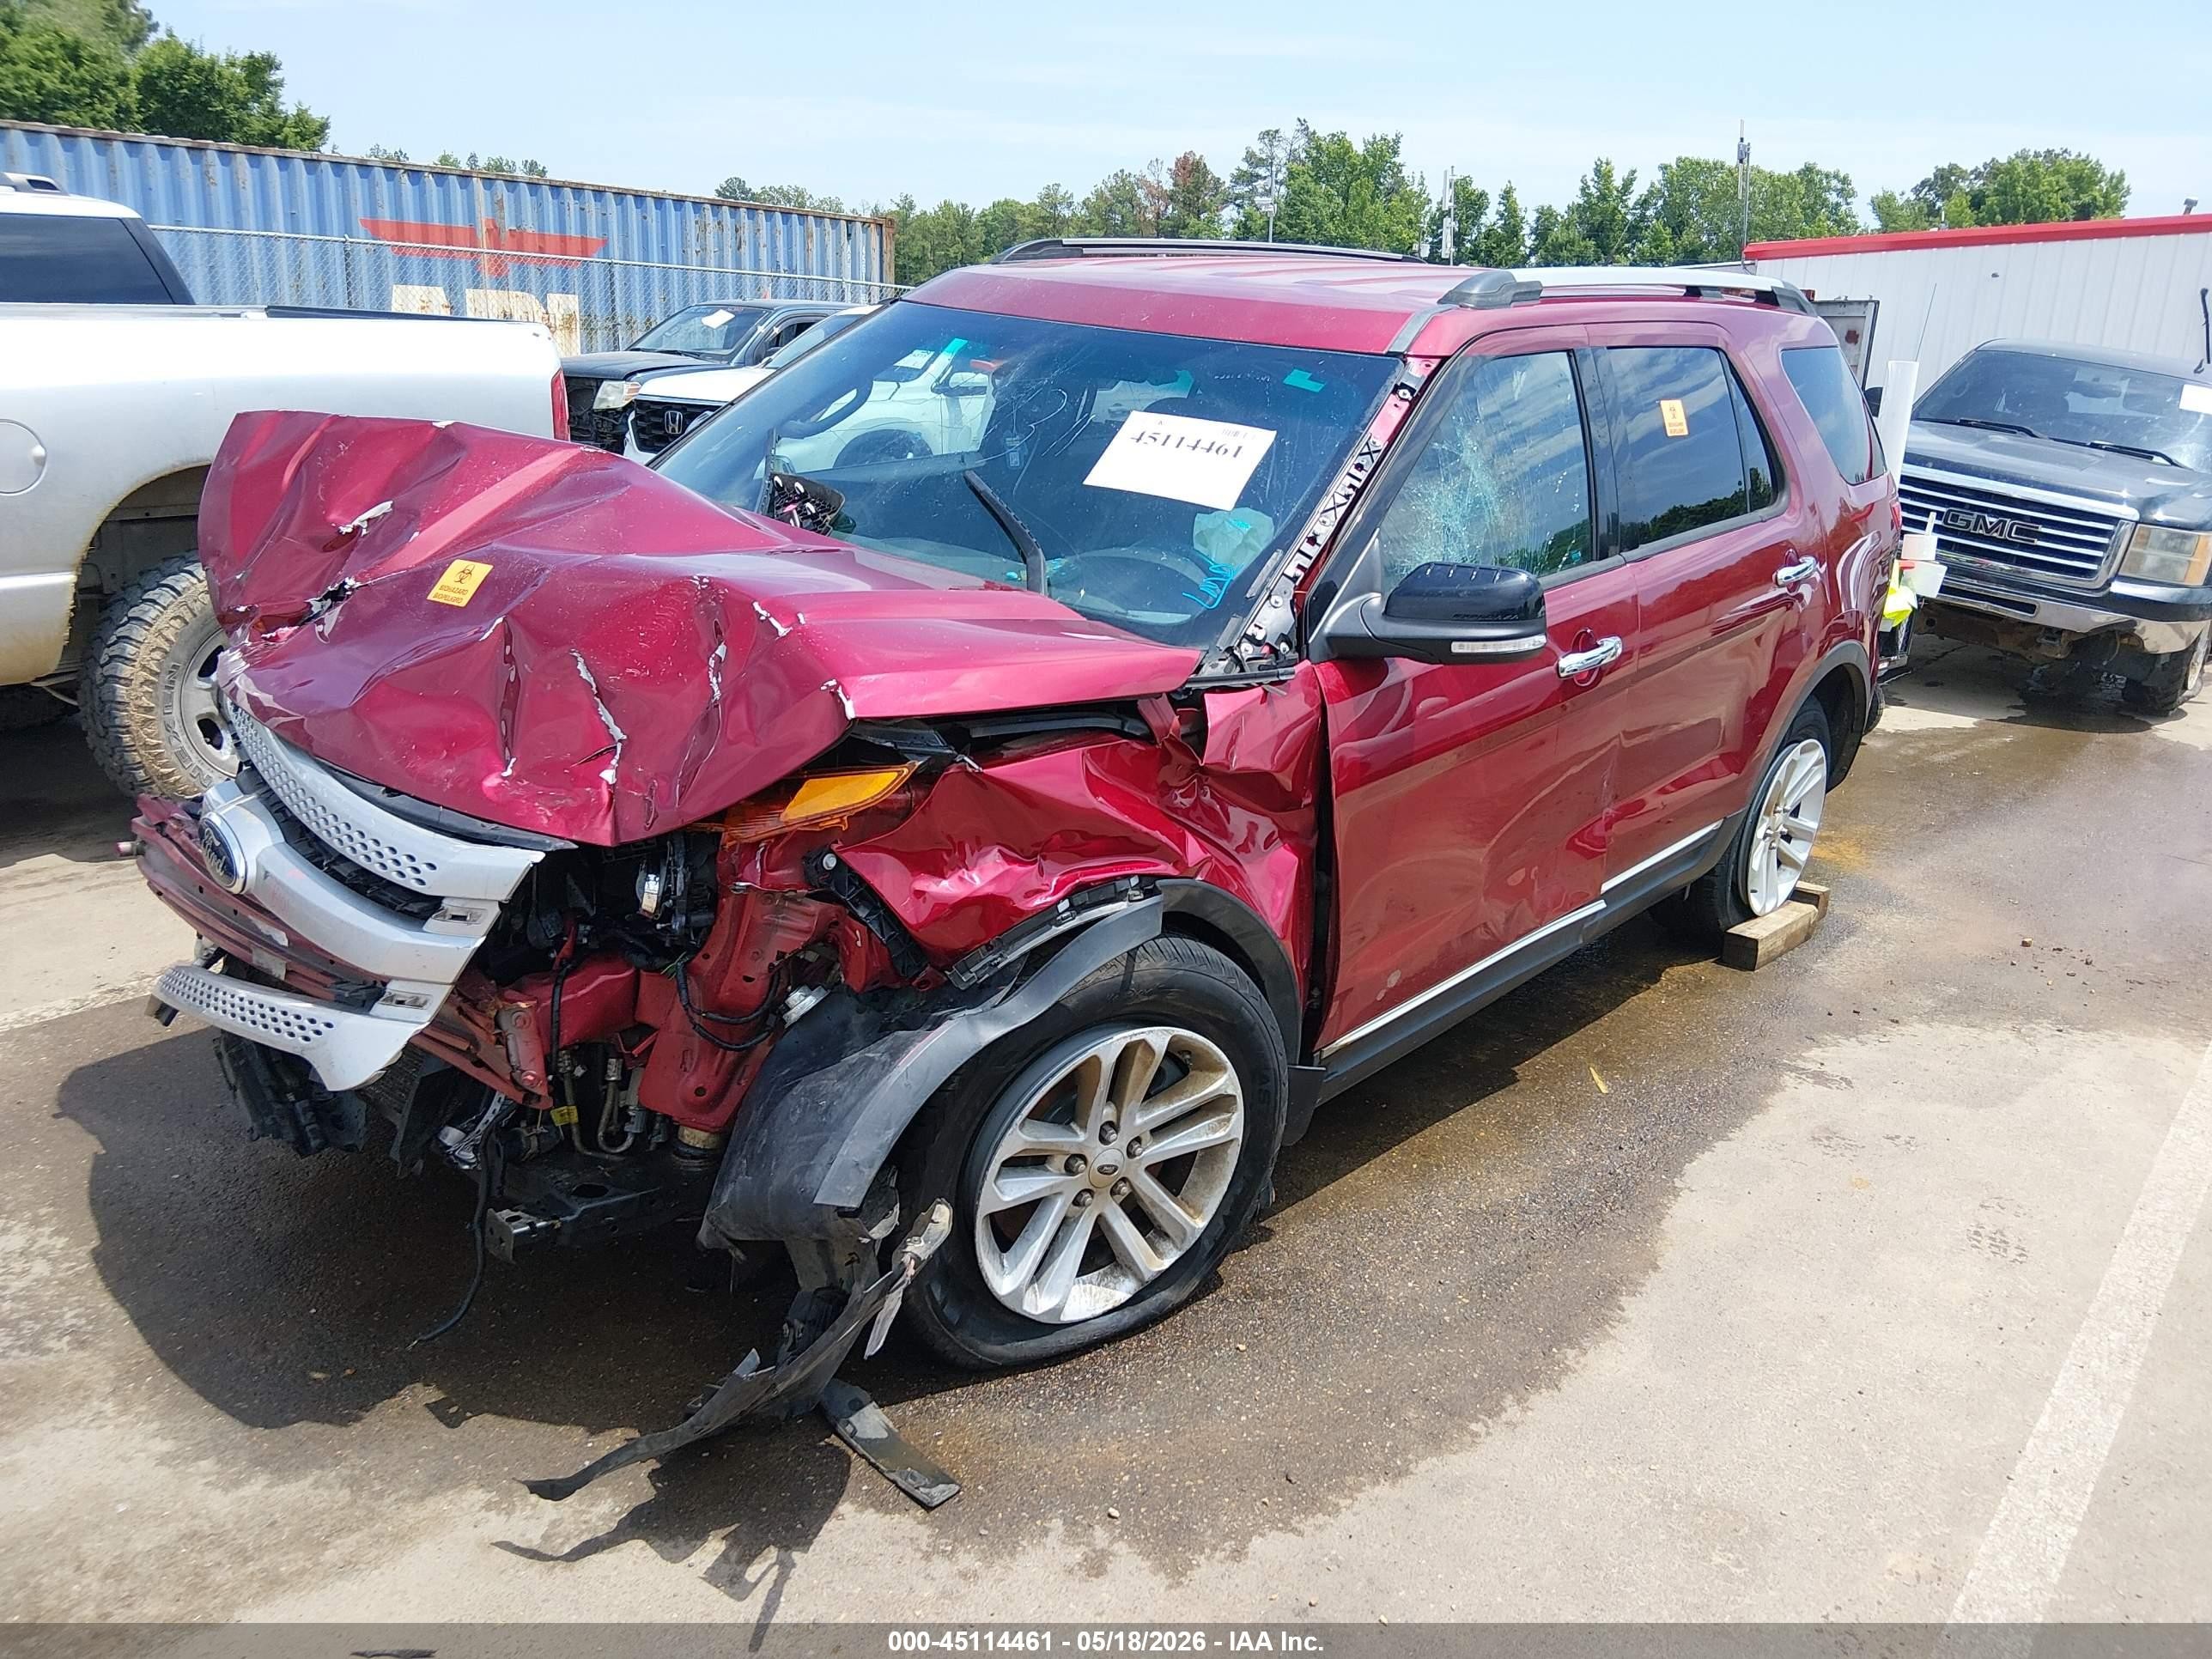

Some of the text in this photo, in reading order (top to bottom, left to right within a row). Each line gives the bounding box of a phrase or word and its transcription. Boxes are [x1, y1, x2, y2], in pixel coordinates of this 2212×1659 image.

[1131, 431, 1243, 458] 45114461
[1942, 507, 2042, 544] GMC
[201, 827, 227, 876] Ford
